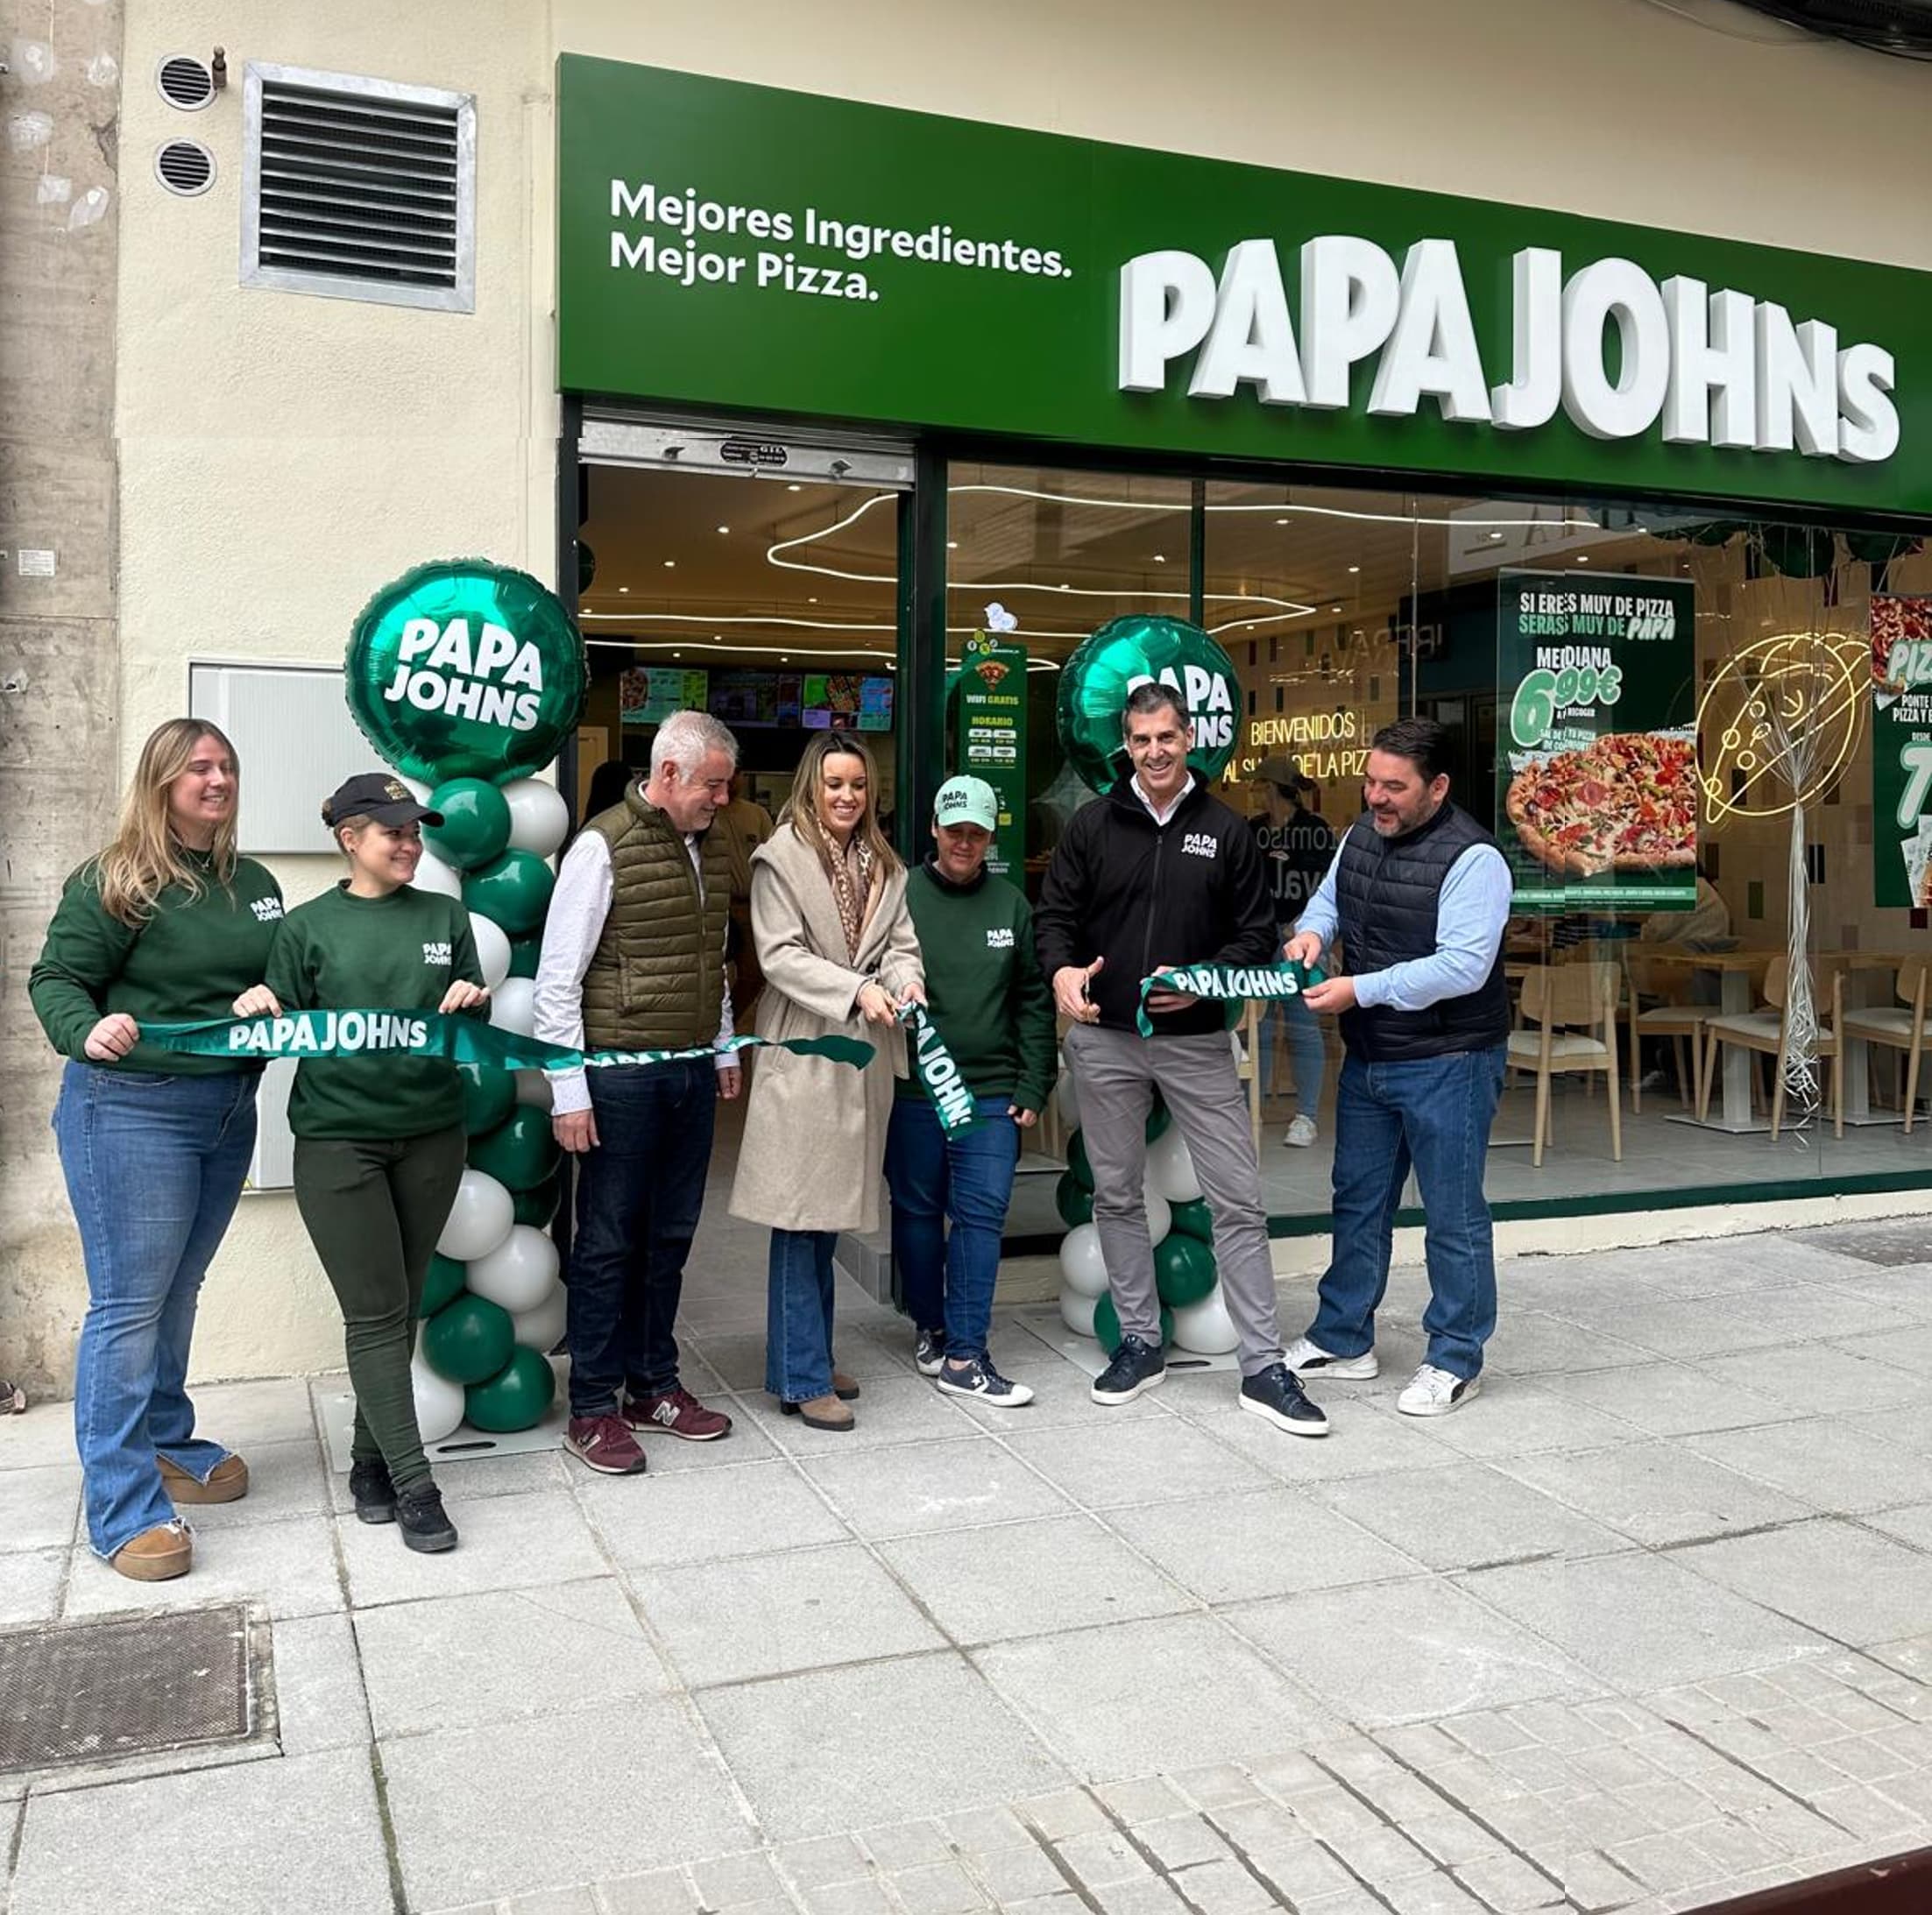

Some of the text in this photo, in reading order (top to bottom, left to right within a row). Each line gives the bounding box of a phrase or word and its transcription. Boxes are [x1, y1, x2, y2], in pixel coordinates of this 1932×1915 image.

[611, 179, 1072, 279] Mejores Ingredientes.
[611, 230, 880, 301] Mejor Pizza.
[1119, 235, 1900, 463] PAPA JOHNS
[1520, 593, 1534, 612] SI
[1580, 594, 1612, 615] MUY
[1615, 596, 1633, 617] DE
[1636, 598, 1674, 618] PIZZA
[1572, 615, 1605, 636] MUY
[1607, 616, 1625, 637] DE
[1625, 618, 1676, 640] PAPA
[398, 618, 542, 692] PAPA
[384, 664, 541, 731] JOHNS
[1250, 711, 1355, 746] BIENVENIDOS
[1893, 707, 1919, 722] PIZZA
[1222, 760, 1242, 783] AL
[1317, 752, 1339, 778] LA
[1341, 749, 1373, 776] PIZ
[942, 790, 968, 802] PAPA
[1181, 843, 1216, 859] JOHNS
[1185, 833, 1217, 849] PAPA
[987, 929, 1014, 940] PAPA
[1227, 969, 1299, 998] JOHNS
[229, 1012, 428, 1051] PAPA JOHNS
[652, 1400, 681, 1427] N
